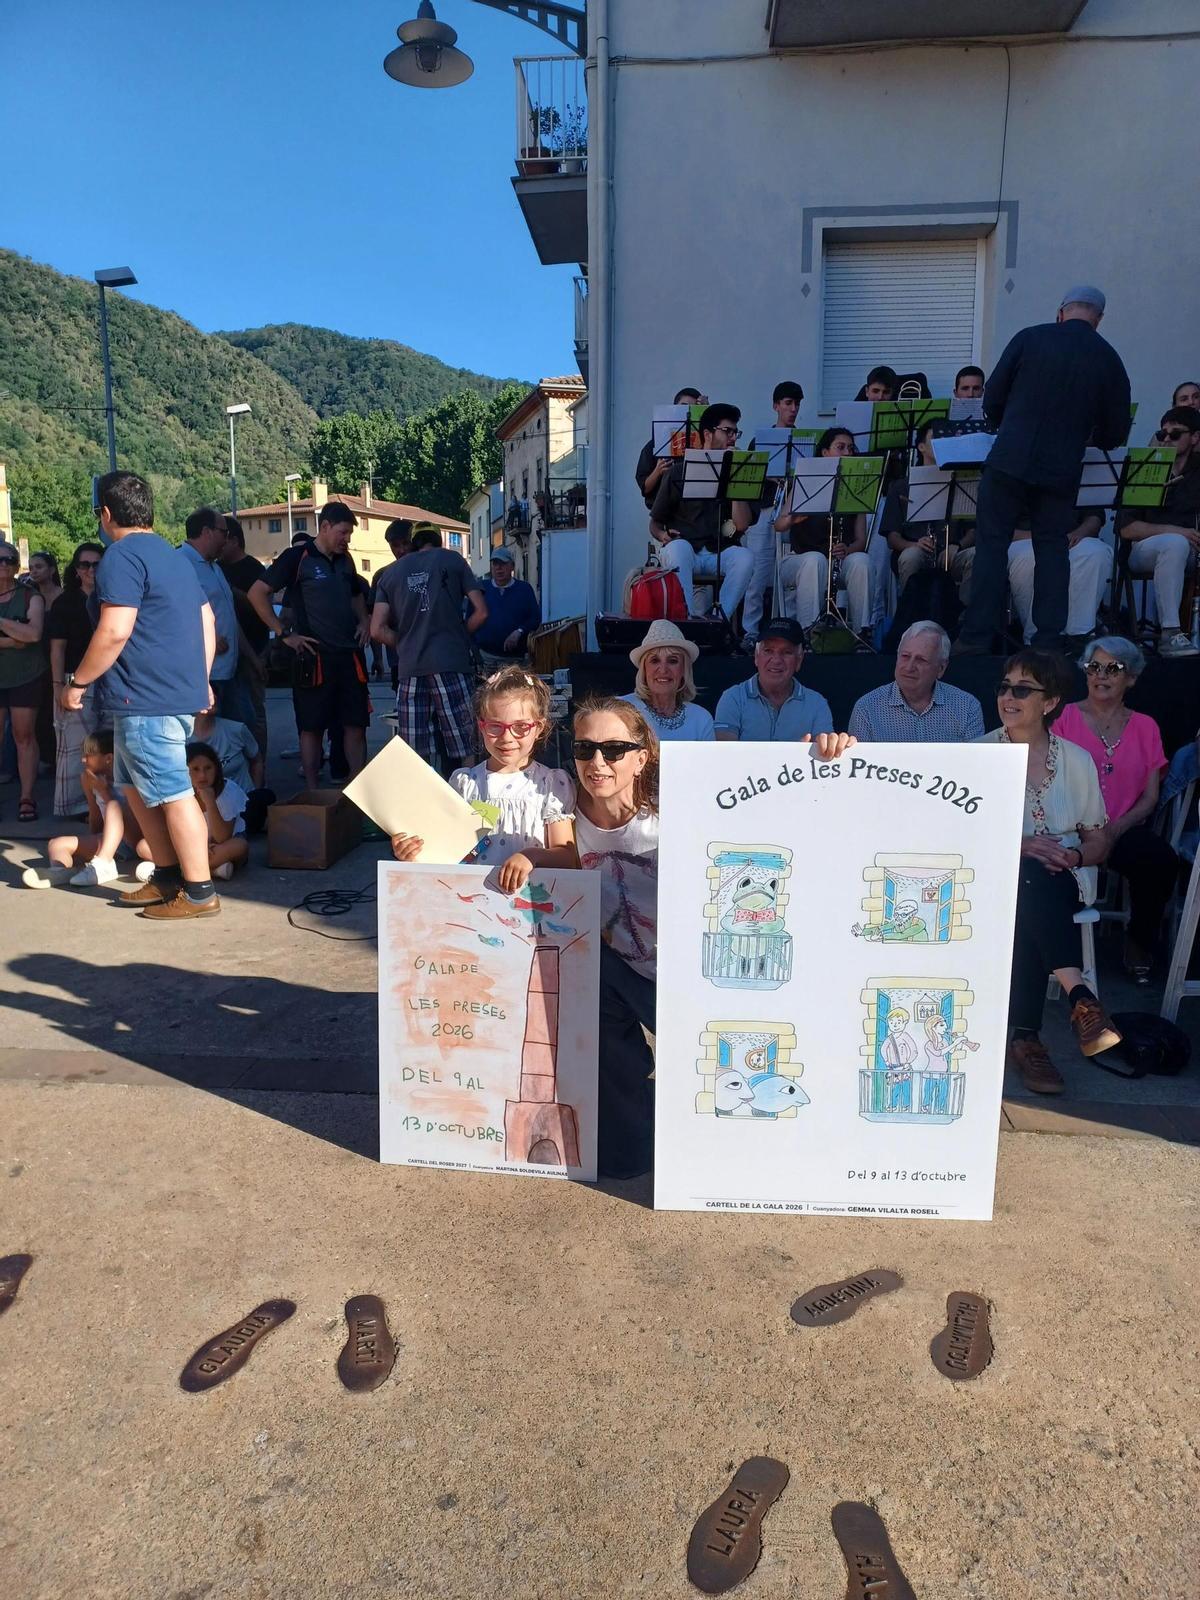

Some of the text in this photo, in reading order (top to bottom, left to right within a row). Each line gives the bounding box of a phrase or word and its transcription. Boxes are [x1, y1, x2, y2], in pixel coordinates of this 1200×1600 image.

[716, 757, 983, 814] Gala de les Preses 2026
[460, 964, 479, 974] DE
[408, 998, 507, 1020] LES PRESES
[432, 1022, 474, 1040] 2026
[402, 1066, 485, 1091] DEL 9 AL
[402, 1115, 504, 1143] 13 D'OCTUBRE
[847, 1170, 967, 1182] Del 9 al 13 d'octubre
[705, 1201, 738, 1209] CARTELL
[785, 1203, 803, 1211] 2026
[707, 1488, 760, 1558] LAURA
